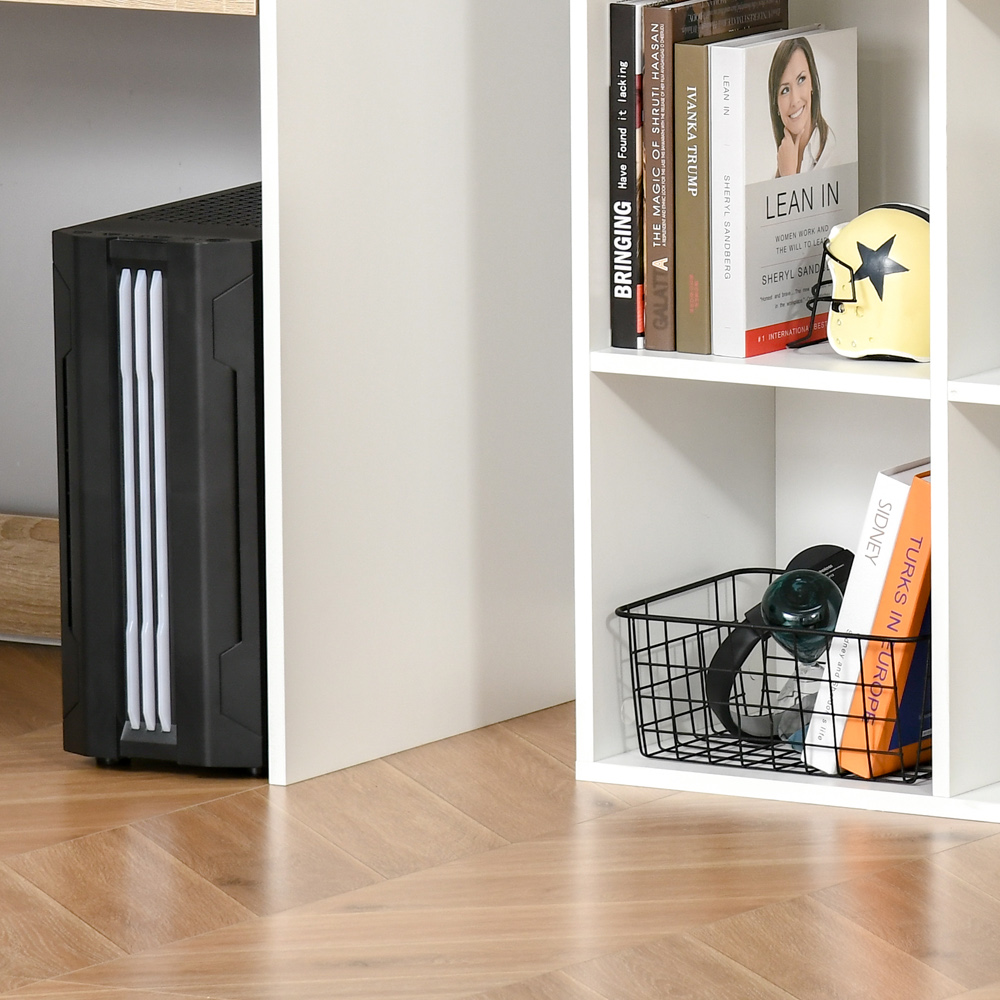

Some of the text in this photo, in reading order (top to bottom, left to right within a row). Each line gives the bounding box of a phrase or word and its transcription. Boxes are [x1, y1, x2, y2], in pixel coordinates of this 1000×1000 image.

[722, 75, 730, 116] LEAN IN
[651, 23, 662, 248] THE MAGIC OF SHRUTI HAASAN
[686, 86, 698, 197] IVANKA TRUMP
[613, 60, 632, 299] BRINGING Have Found it lacking
[766, 181, 839, 220] LEAN IN
[723, 175, 731, 280] SHERYL SANDBERG
[775, 224, 829, 242] WOMEN WORK AND
[776, 245, 787, 254] THE
[789, 243, 802, 252] WILL
[804, 240, 812, 248] TO
[762, 269, 794, 285] SHERYL
[768, 325, 811, 340] INTERNATIONA
[865, 499, 892, 566] SIDNEY
[894, 537, 923, 605] TURKS
[887, 610, 902, 633] IN
[841, 628, 853, 660] Sdney
[834, 662, 843, 678] and
[818, 726, 827, 740] life
